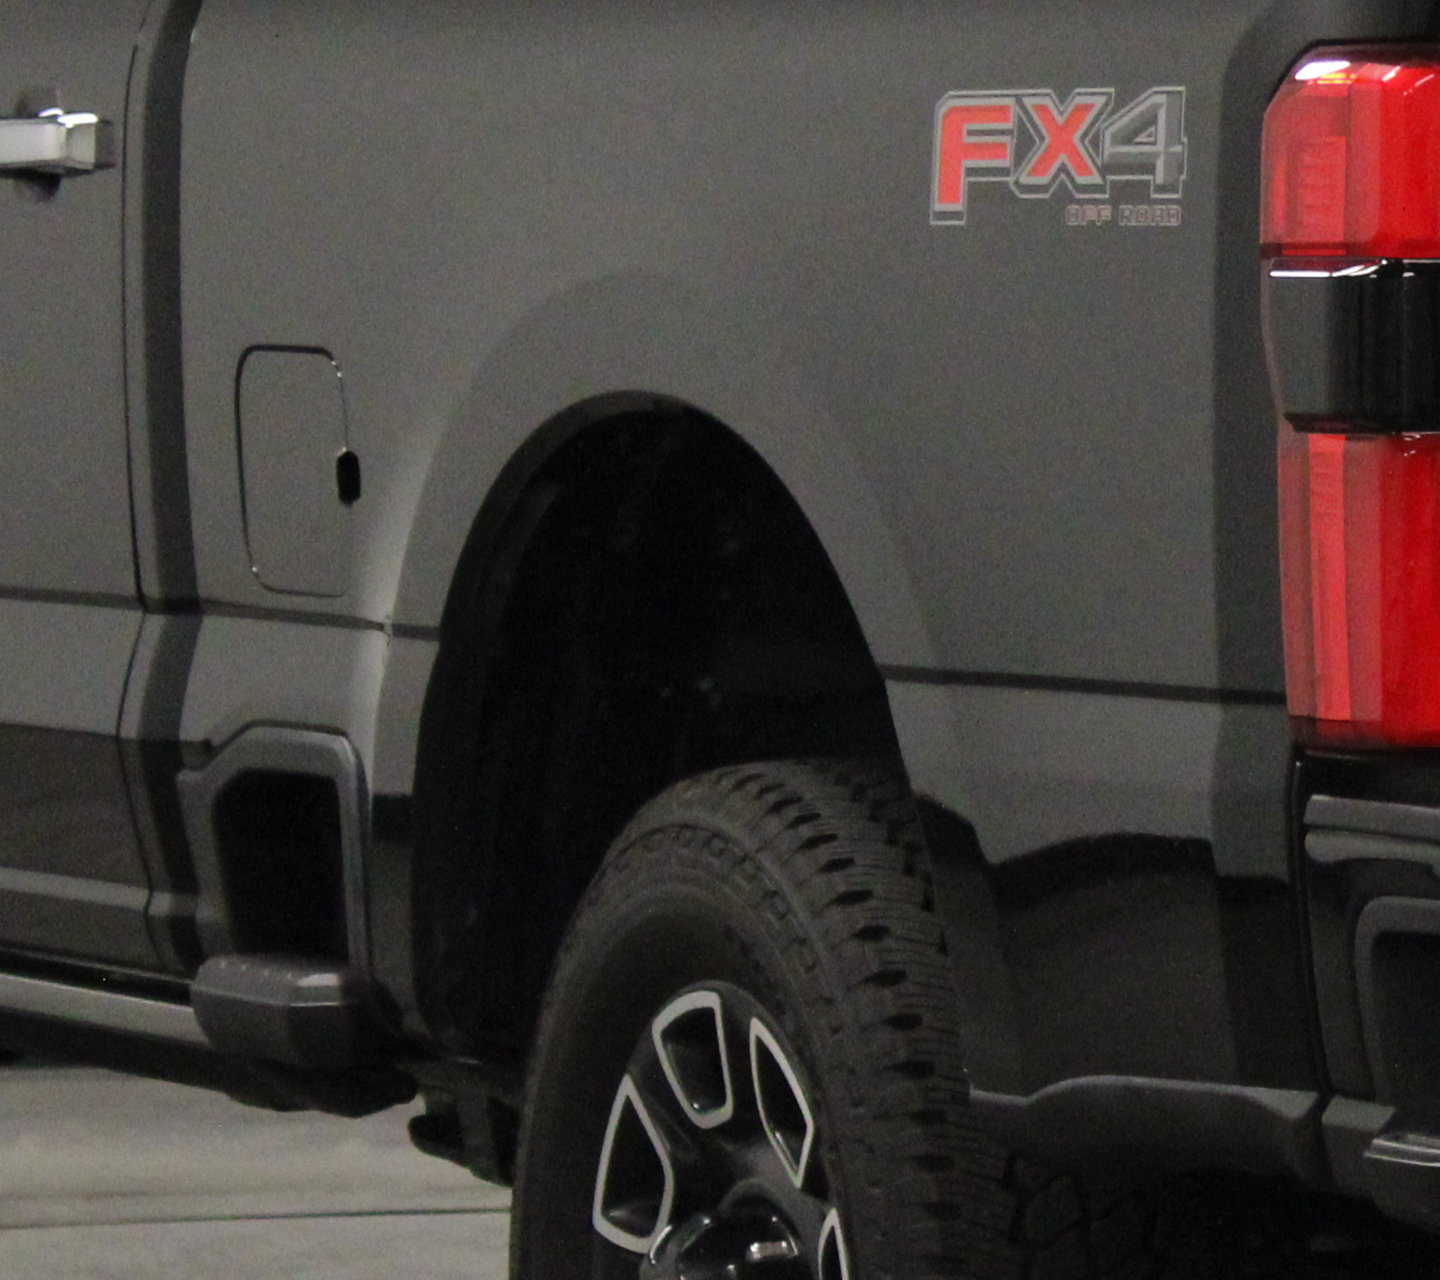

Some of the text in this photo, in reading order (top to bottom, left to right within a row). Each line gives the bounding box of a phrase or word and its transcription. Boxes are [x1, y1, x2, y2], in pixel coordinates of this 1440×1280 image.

[929, 86, 1187, 226] FX4
[1065, 204, 1182, 226] OFF ROAD
